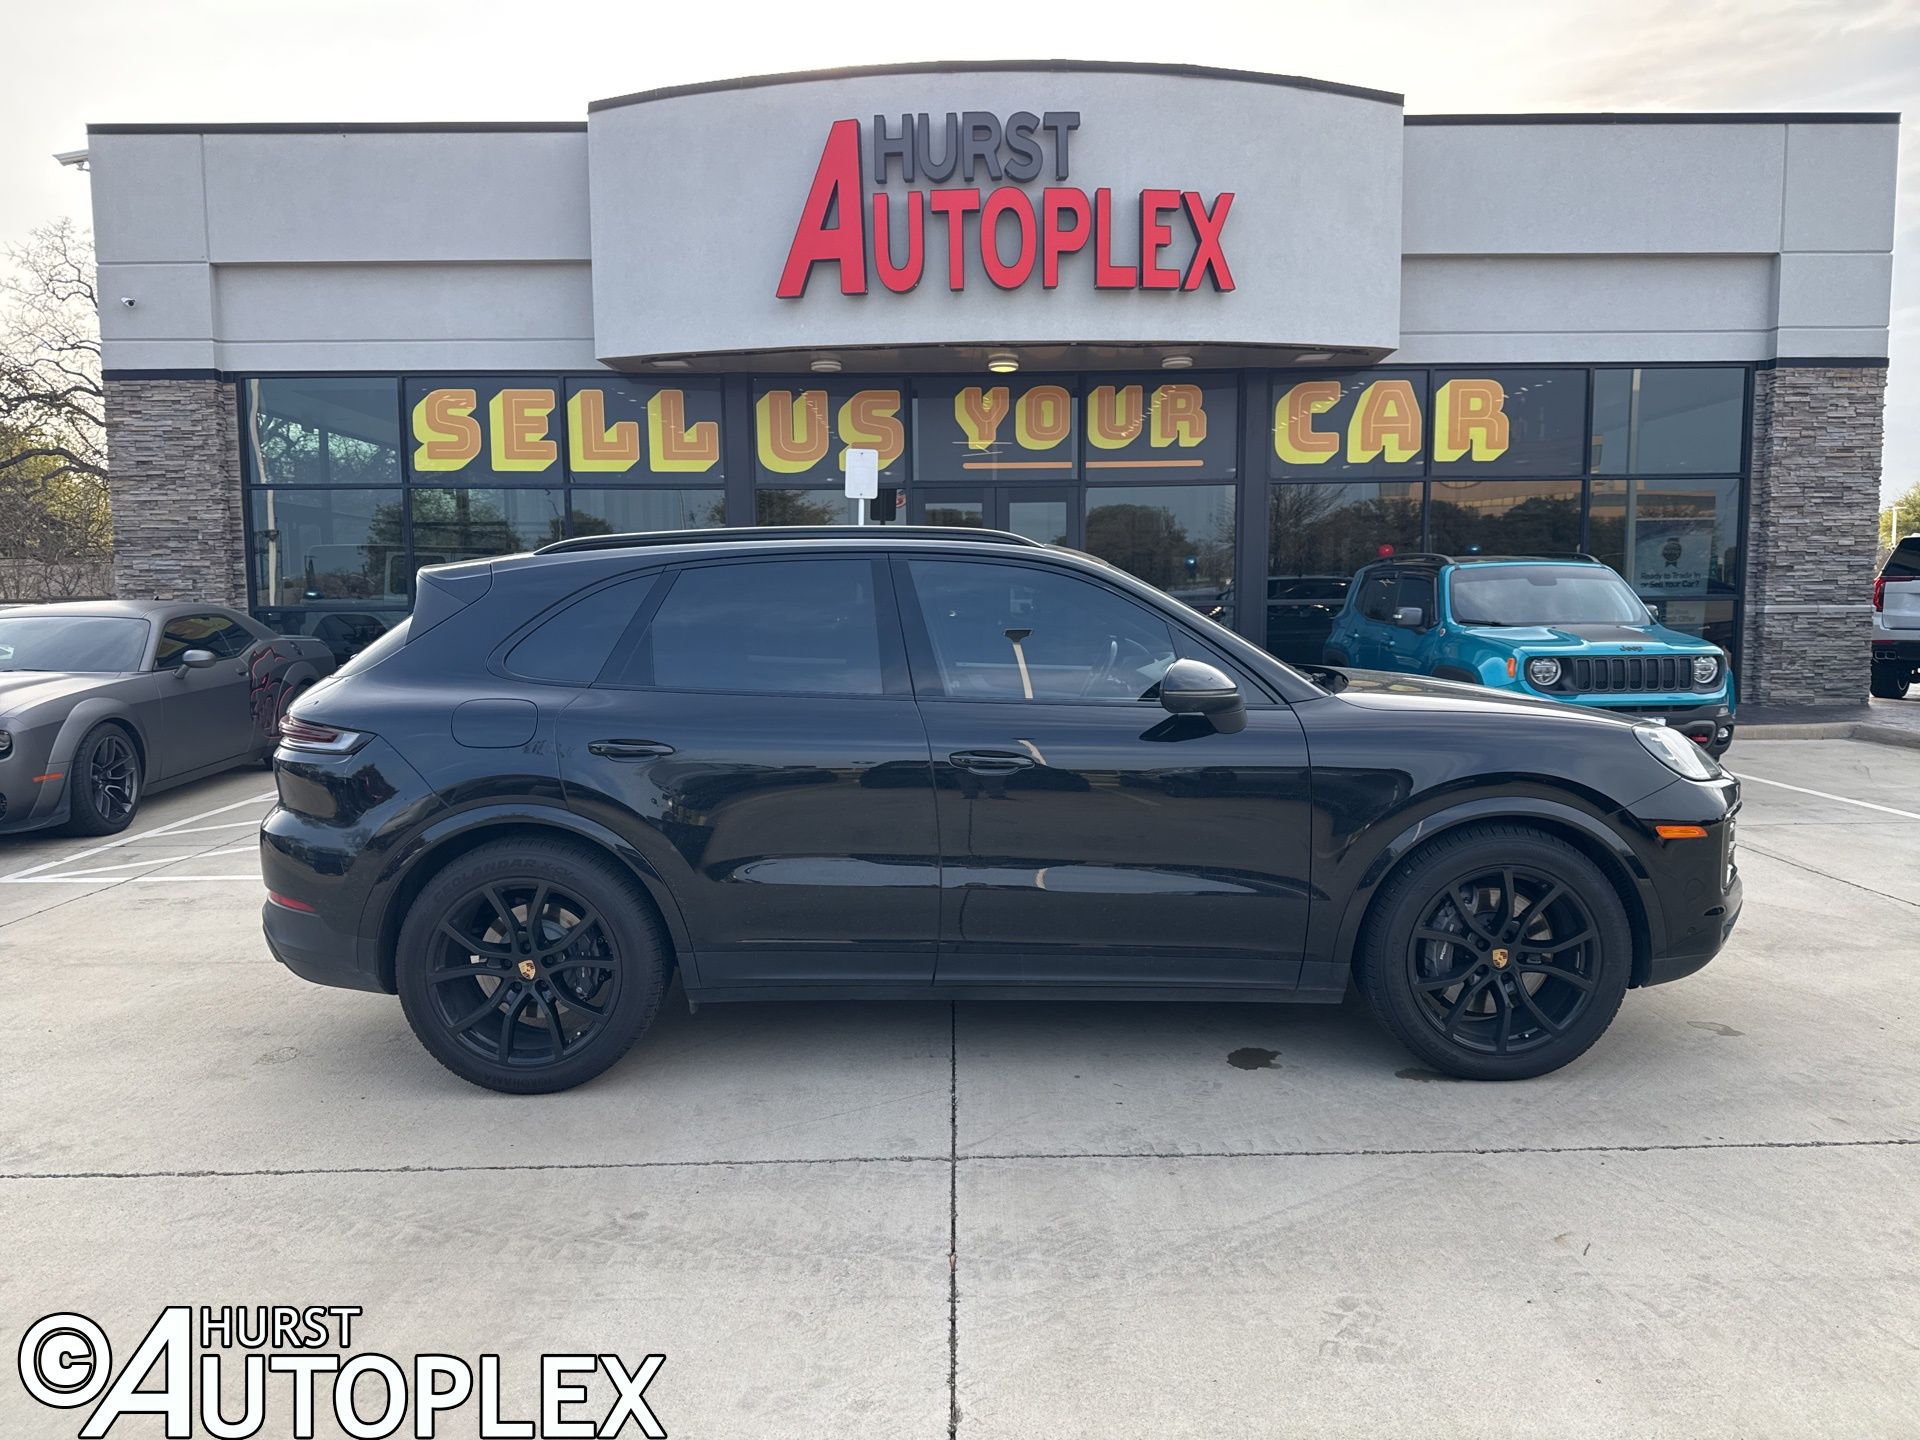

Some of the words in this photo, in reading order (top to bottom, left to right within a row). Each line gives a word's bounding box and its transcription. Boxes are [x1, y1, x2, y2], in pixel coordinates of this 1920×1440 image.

[874, 111, 1080, 184] HURST
[776, 119, 1235, 299] AUTOPLEX
[412, 388, 719, 472] SELL
[755, 389, 905, 473] US
[954, 384, 1207, 451] YOUR
[1274, 379, 1510, 464] CAR
